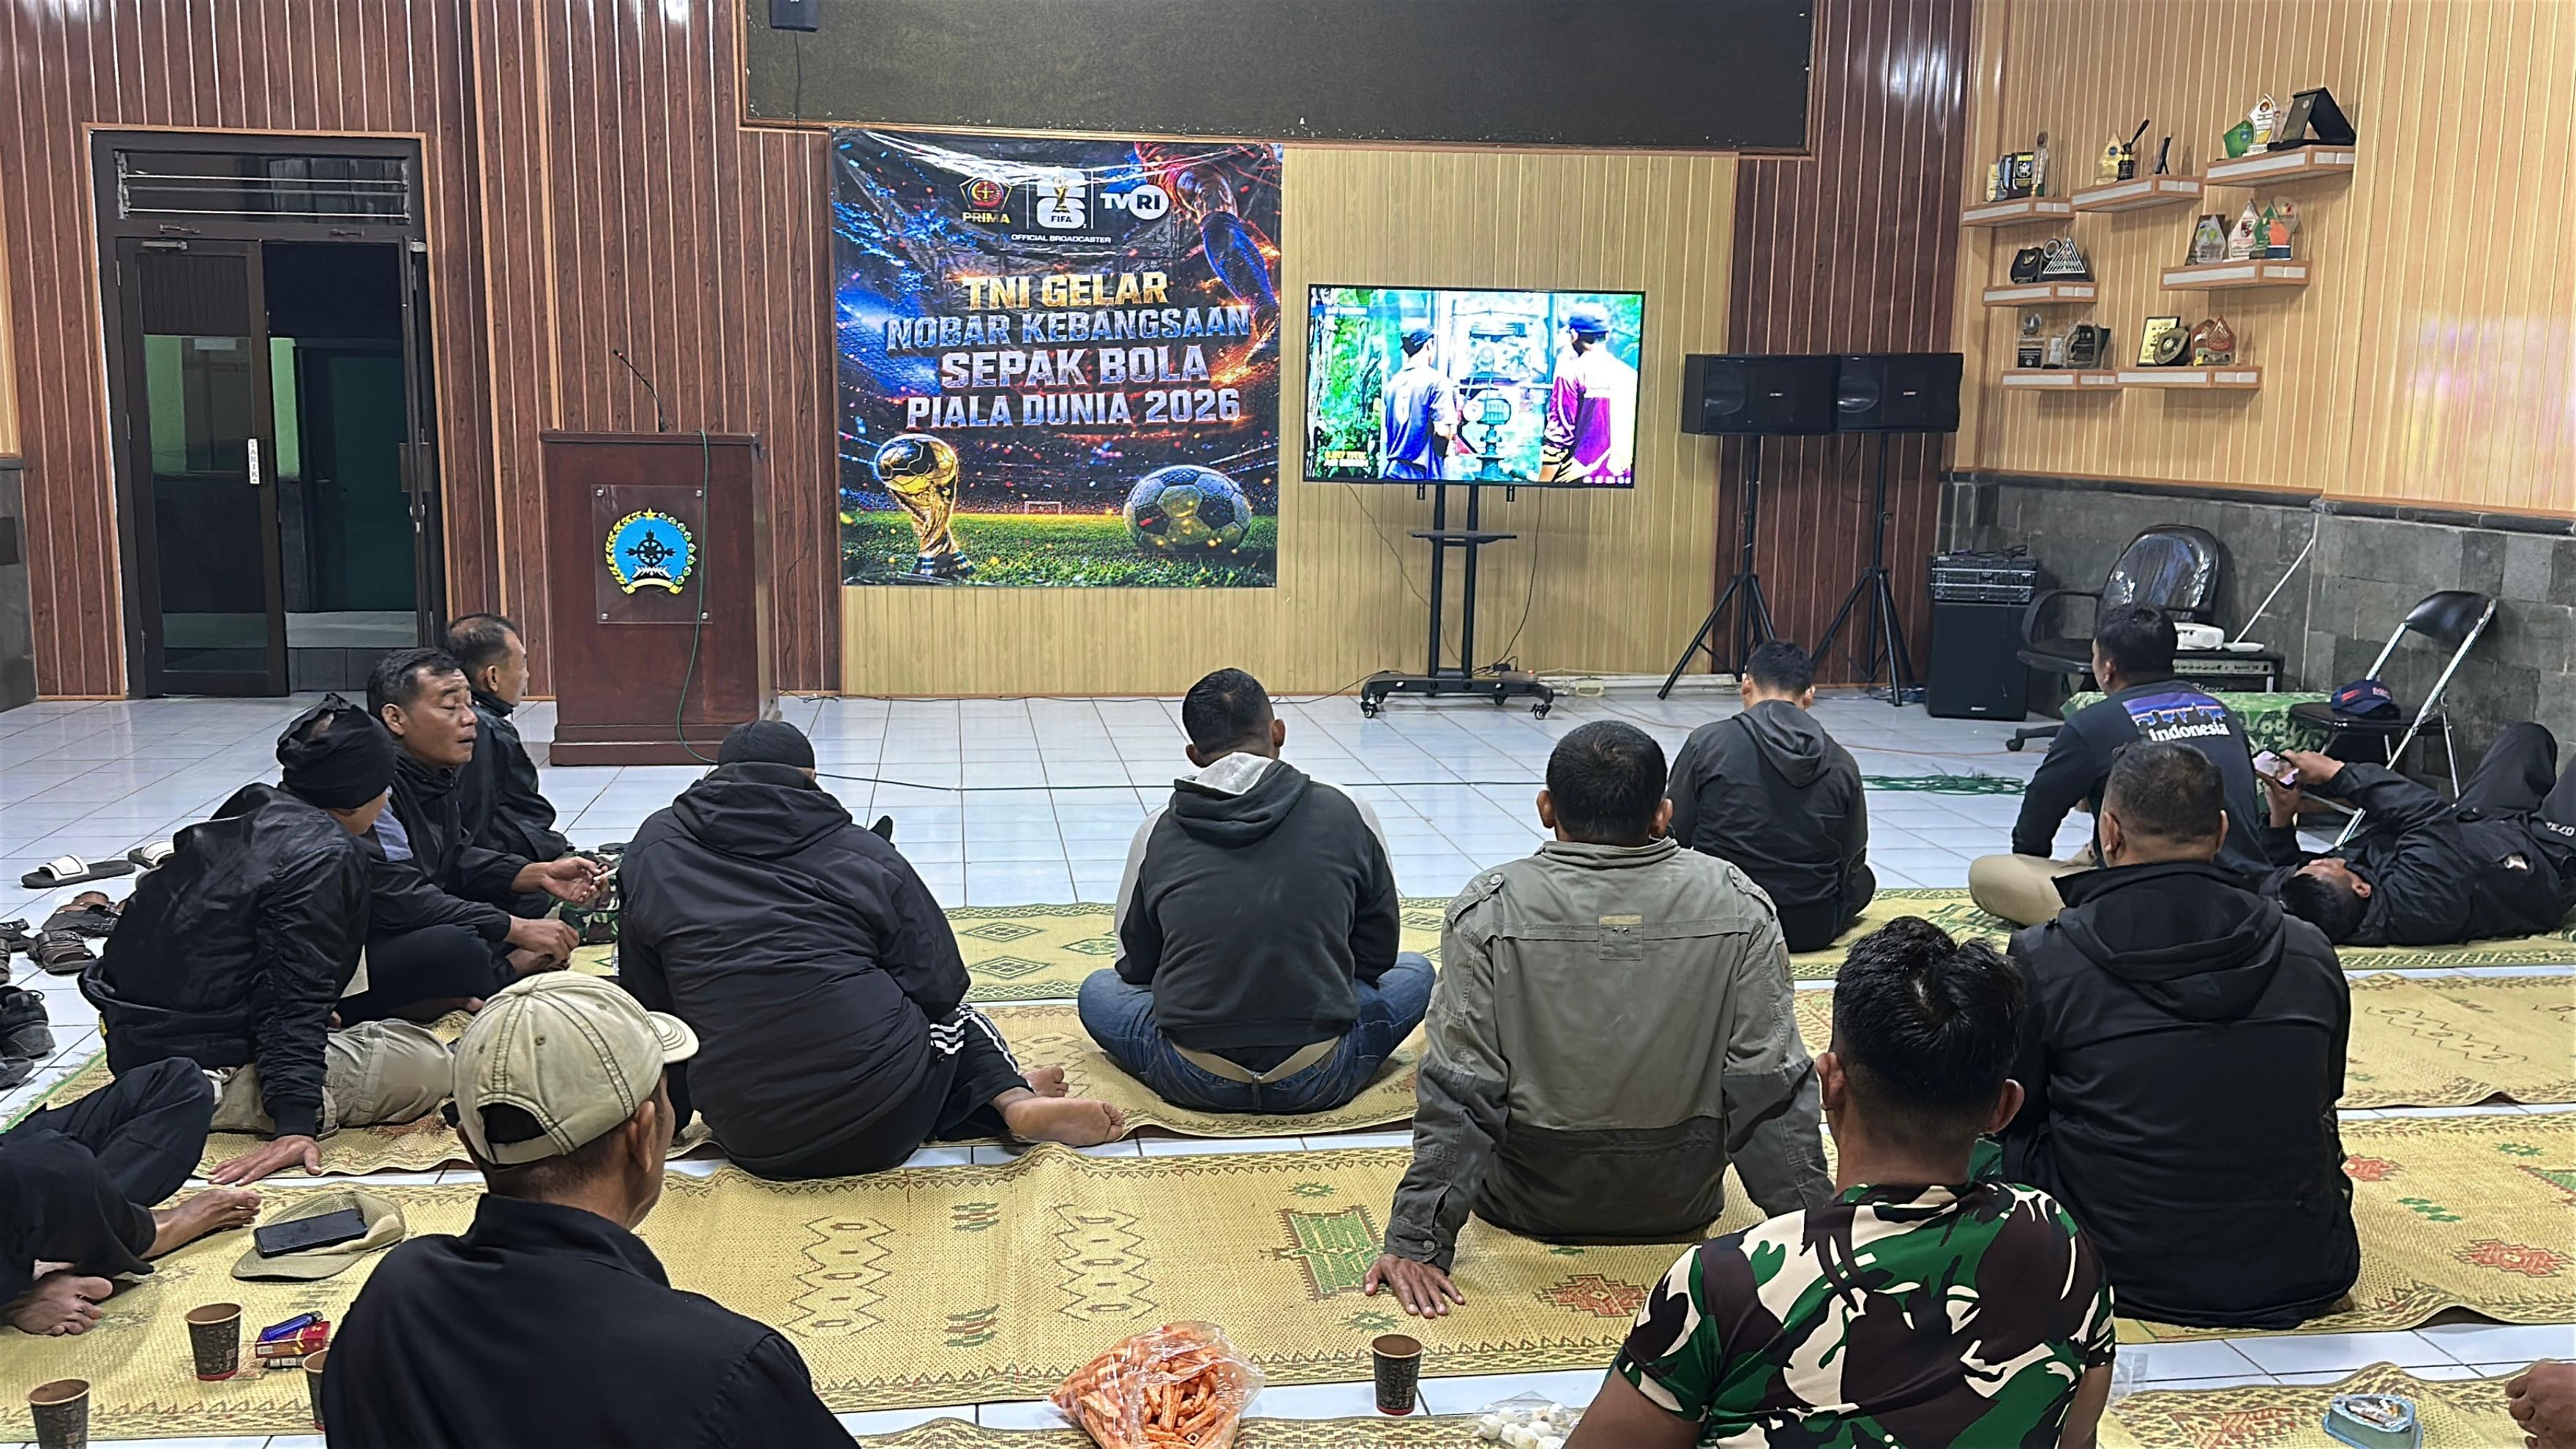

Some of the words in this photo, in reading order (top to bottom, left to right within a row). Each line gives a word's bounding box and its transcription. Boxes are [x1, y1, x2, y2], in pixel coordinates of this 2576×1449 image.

[962, 211, 1011, 224] PRIMA
[1011, 233, 1048, 242] OFFICIAL
[1049, 235, 1112, 244] BROADCASTER
[964, 277, 1030, 311] TNI
[1041, 272, 1169, 307] GELAR
[886, 314, 1011, 351] NOBAR
[1022, 306, 1251, 345] KEBANGSAAN
[941, 348, 1089, 389] SEPAK
[1098, 345, 1210, 385] BOLA
[905, 395, 1014, 430] PIALA
[1023, 392, 1133, 427] DUNIA
[1145, 388, 1241, 424] 2026
[250, 441, 258, 478] TARIK
